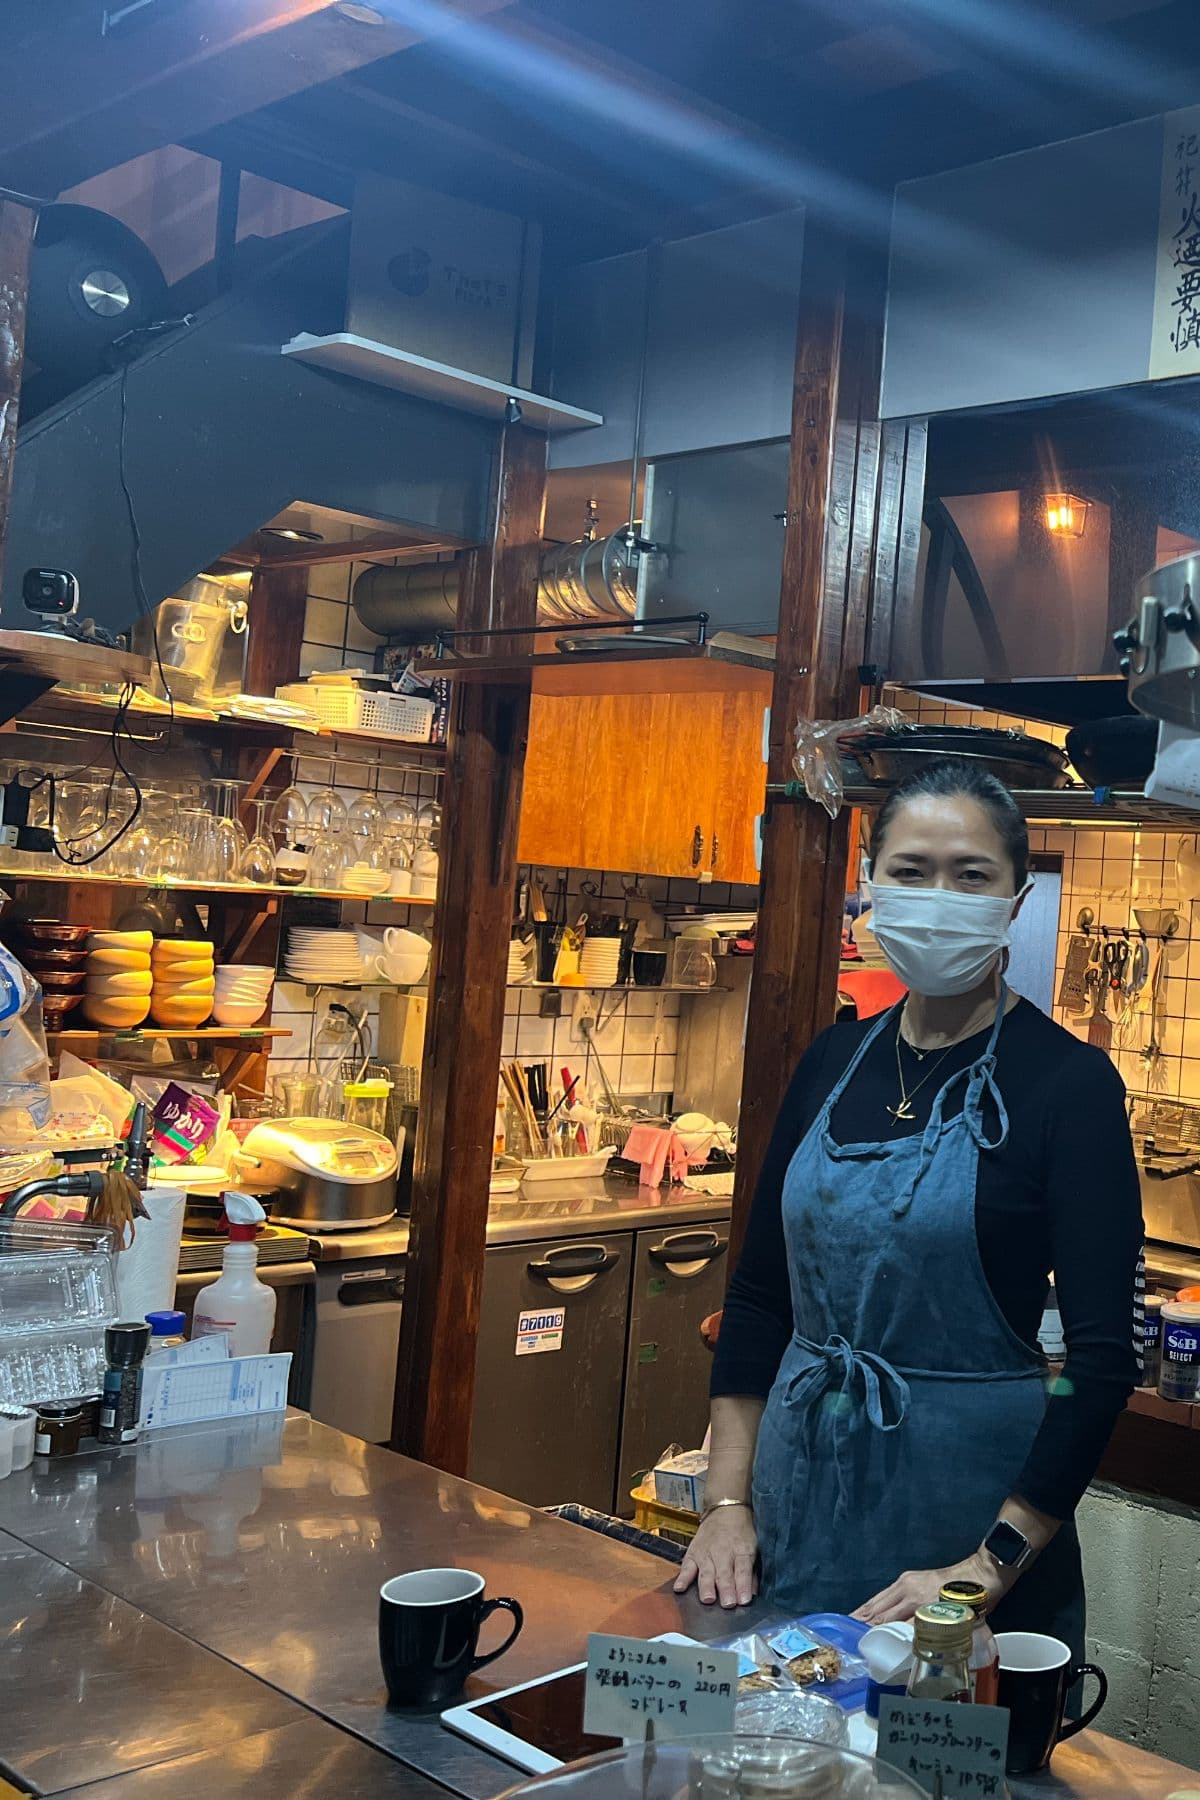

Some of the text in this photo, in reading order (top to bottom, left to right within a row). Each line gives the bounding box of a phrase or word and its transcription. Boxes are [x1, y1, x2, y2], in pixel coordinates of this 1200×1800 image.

[162, 1101, 205, 1140] ゆかり
[1167, 1334, 1198, 1351] S&B
[1169, 1350, 1193, 1363] SELECT
[694, 1681, 731, 1697] 220円
